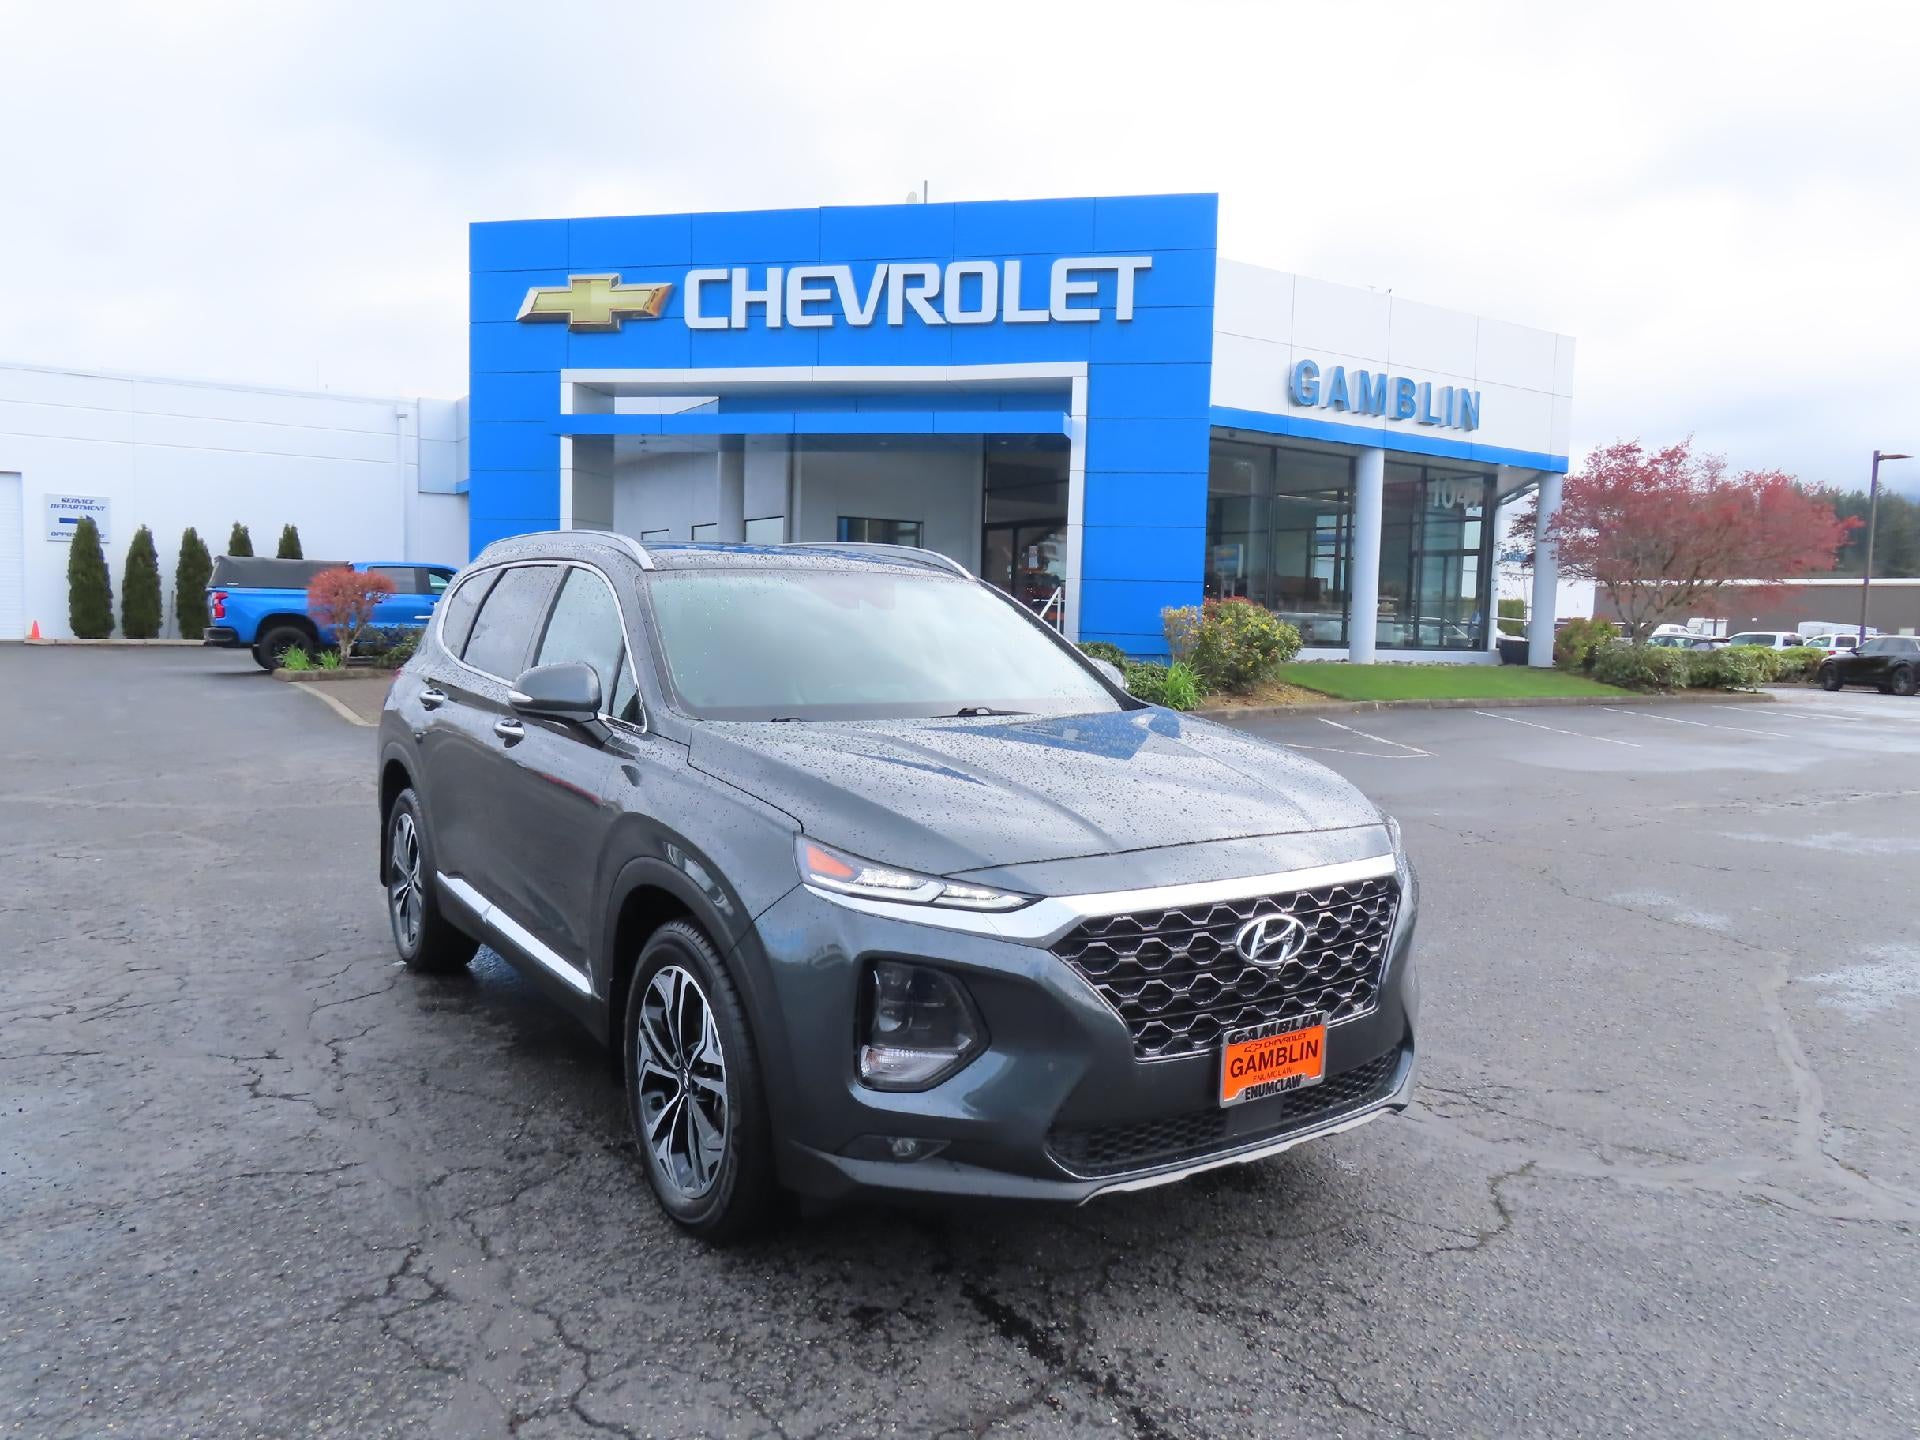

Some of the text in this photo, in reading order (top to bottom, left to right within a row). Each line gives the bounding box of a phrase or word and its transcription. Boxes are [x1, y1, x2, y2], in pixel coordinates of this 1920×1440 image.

[684, 256, 1152, 329] CHEVROLET
[1289, 359, 1480, 431] GAMBLIN
[50, 503, 105, 511] DEPARTMENT
[1228, 1012, 1323, 1044] GAMBLIN
[1263, 1032, 1307, 1048] CHEVROLET
[1230, 1039, 1319, 1078] GAMBLIN
[1244, 1073, 1303, 1100] ENUMCLAW
